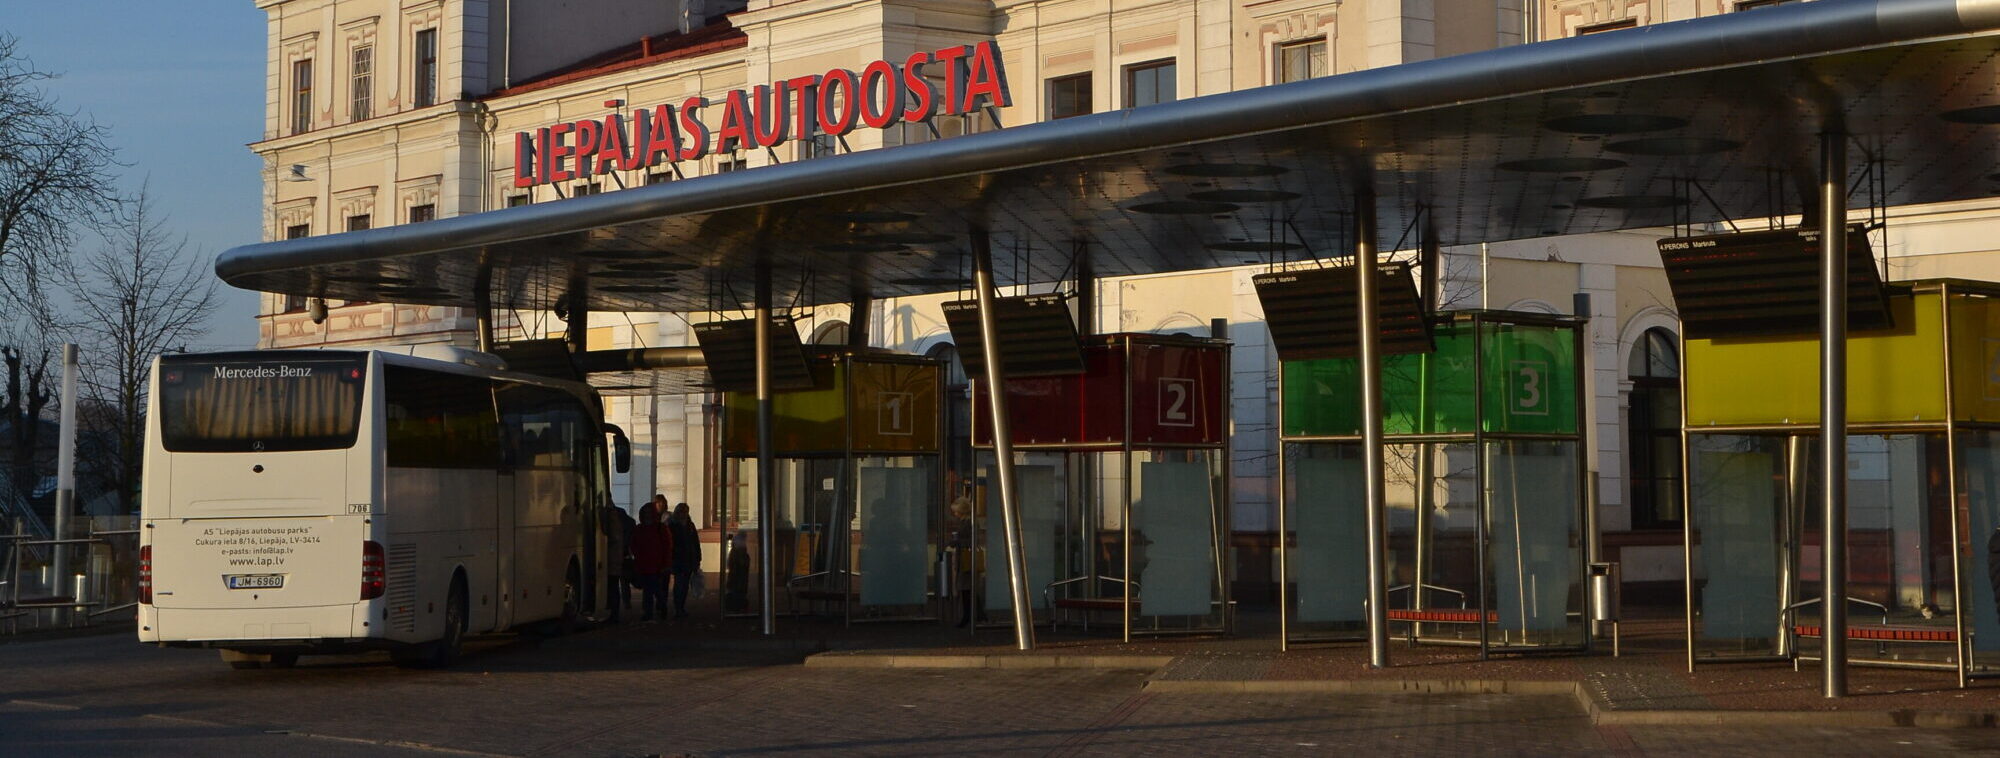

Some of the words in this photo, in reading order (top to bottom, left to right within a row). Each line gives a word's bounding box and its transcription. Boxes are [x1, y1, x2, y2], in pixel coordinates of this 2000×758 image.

[514, 97, 710, 188] LIEPĀJAS
[717, 40, 1013, 154] AUTOOSTA
[213, 365, 312, 379] Mercedes-Benz
[1519, 367, 1540, 408] 3
[1166, 383, 1186, 419] 2
[886, 397, 900, 429] 1
[351, 504, 368, 513] 706
[204, 528, 214, 536] AS
[251, 527, 286, 535] autobusu
[195, 538, 222, 546] Cukura
[223, 537, 237, 546] iela
[289, 536, 321, 545] LV-3414
[221, 548, 251, 556] e-pasts:
[252, 547, 294, 556] info@lap.lv
[229, 557, 285, 567] www.lap.lv
[237, 577, 281, 587] JM-6960
